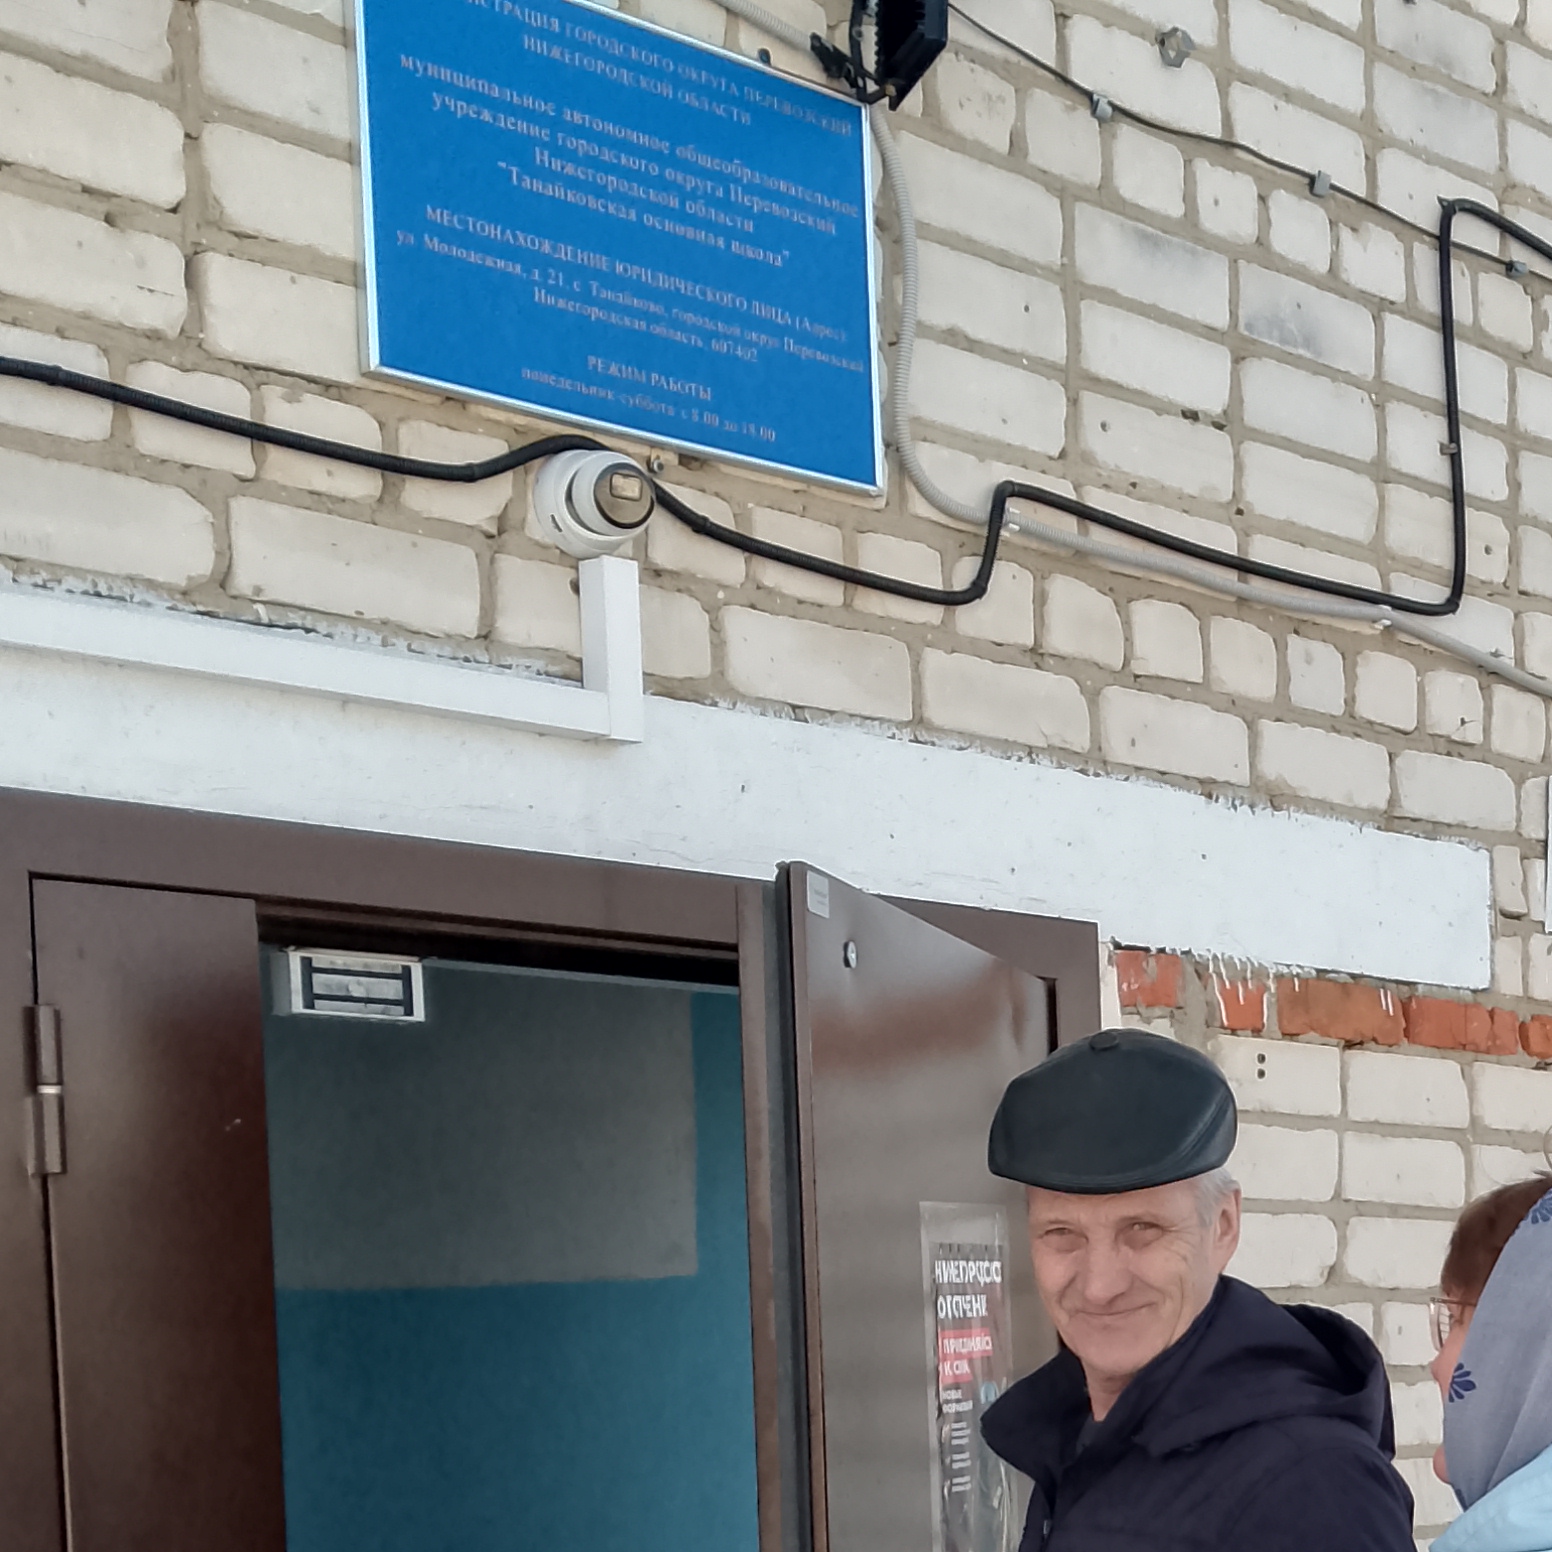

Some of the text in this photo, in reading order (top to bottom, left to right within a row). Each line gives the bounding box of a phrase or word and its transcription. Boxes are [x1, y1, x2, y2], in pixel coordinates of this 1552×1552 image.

[523, 34, 751, 125] НИЖЕГОРОДСКОЙ ОБЛАСТИ
[565, 22, 674, 73] ГОРОДСКОГО
[677, 64, 739, 97] ОКРУГА
[399, 54, 859, 217] муниципальное автономное общеобразовательное
[432, 91, 836, 235] учреждение городского округа Перевозский
[535, 146, 753, 232] Нижегородской области
[426, 204, 611, 272] МЕСТОНАХОЖДЕНИЕ
[616, 261, 747, 312] ЮРИДИЧЕСКОГО
[752, 300, 791, 326] ЛИЦА
[643, 213, 725, 250] основная
[731, 239, 790, 267] школа"
[534, 287, 646, 332] Нижегородская
[672, 308, 741, 337] городской
[587, 355, 711, 400] РЕЖИМ РАБОТЫ
